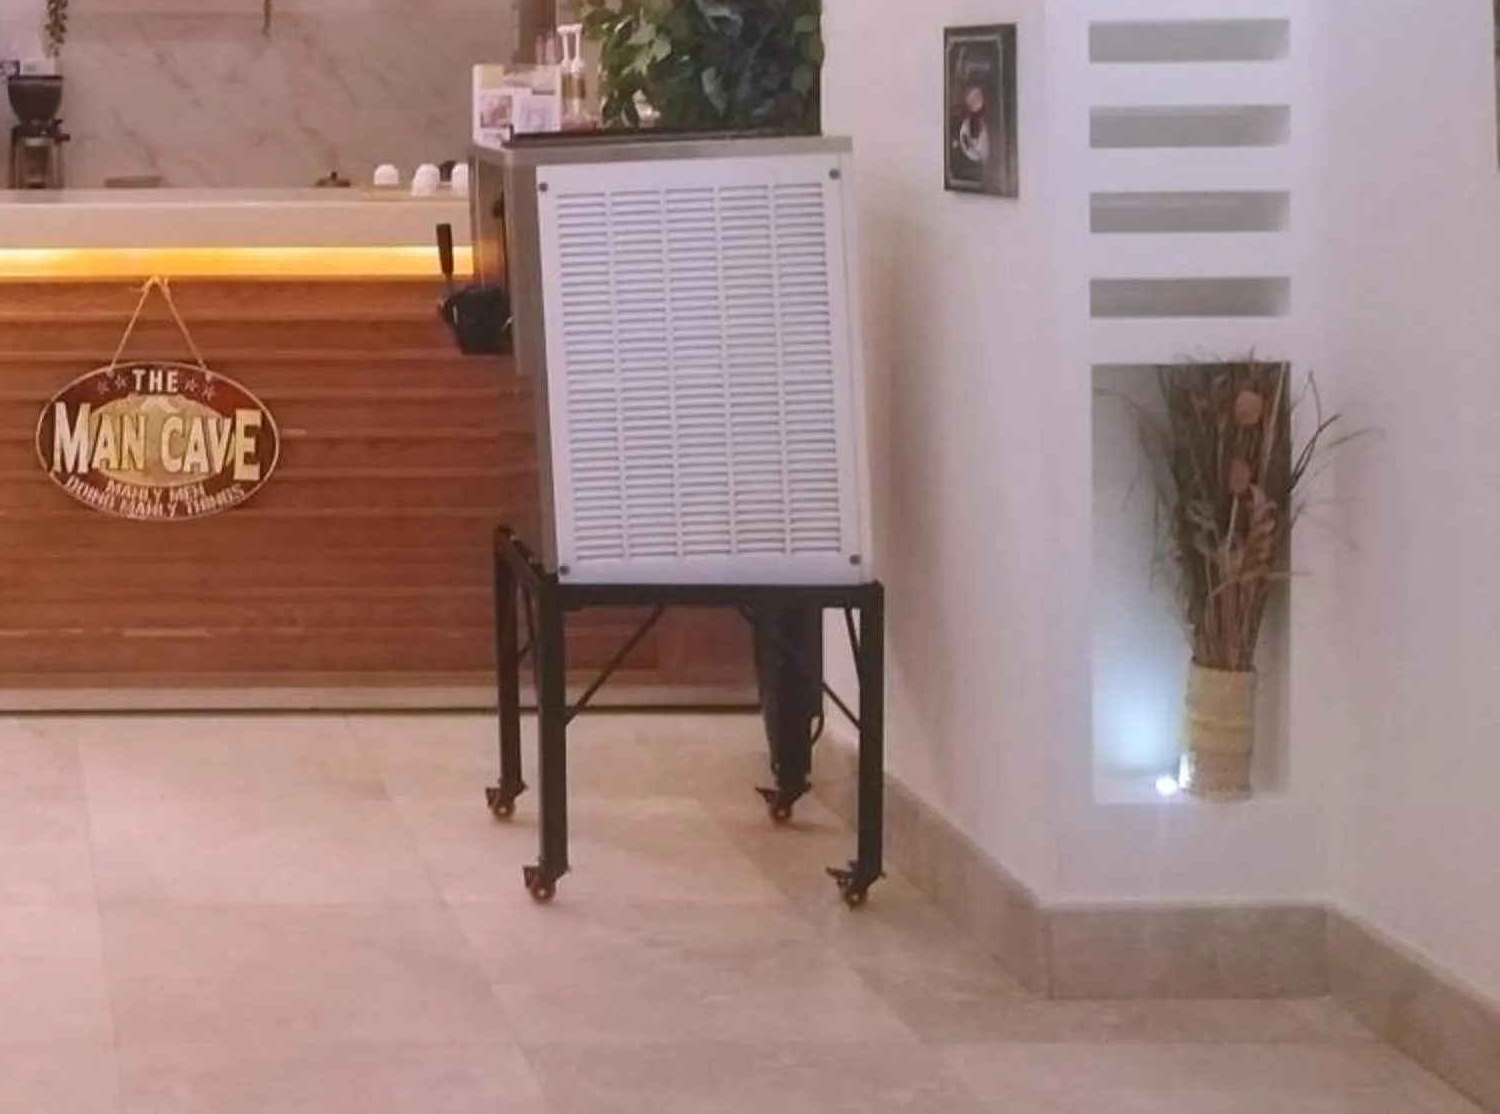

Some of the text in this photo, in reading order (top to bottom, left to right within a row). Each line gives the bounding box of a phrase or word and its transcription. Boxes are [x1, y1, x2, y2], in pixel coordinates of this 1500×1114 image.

[131, 369, 179, 393] THE
[53, 401, 262, 482] MAN CAVE
